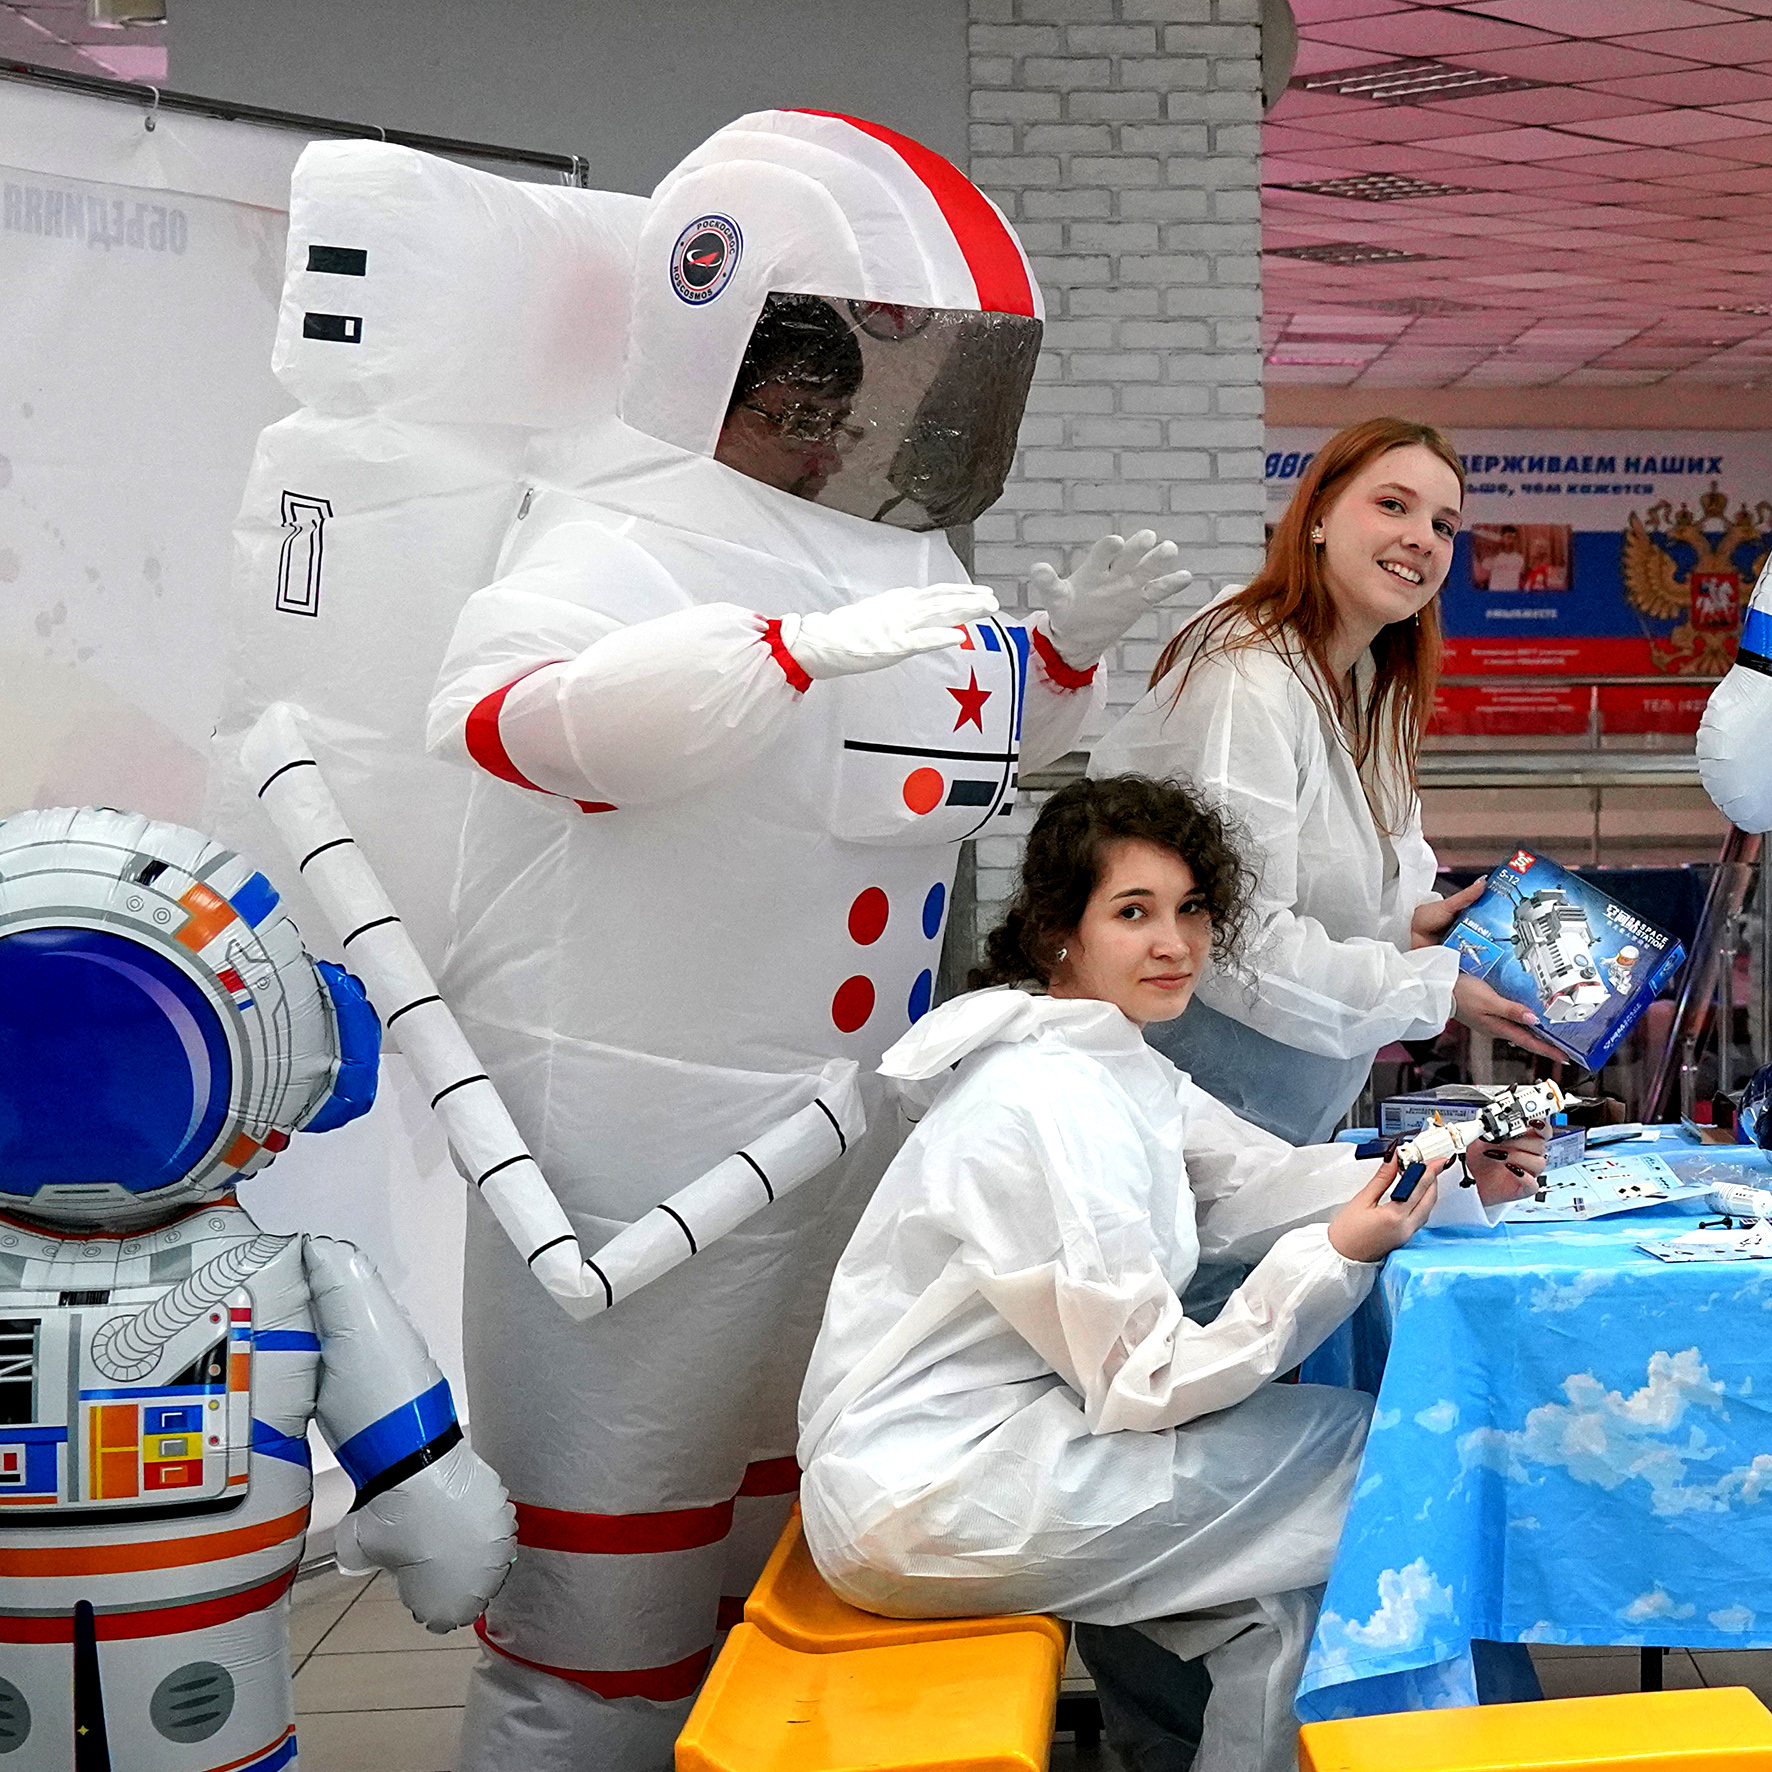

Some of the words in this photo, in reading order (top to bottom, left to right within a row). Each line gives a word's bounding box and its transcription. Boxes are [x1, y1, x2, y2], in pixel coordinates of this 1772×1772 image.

[696, 220, 736, 255] РОСКОСМОС
[673, 265, 713, 300] ROSCOSMOS
[1624, 456, 1724, 474] НАШИХ
[1499, 869, 1520, 885] 5-12
[1635, 930, 1665, 951] STATION
[1640, 923, 1669, 945] SPACE
